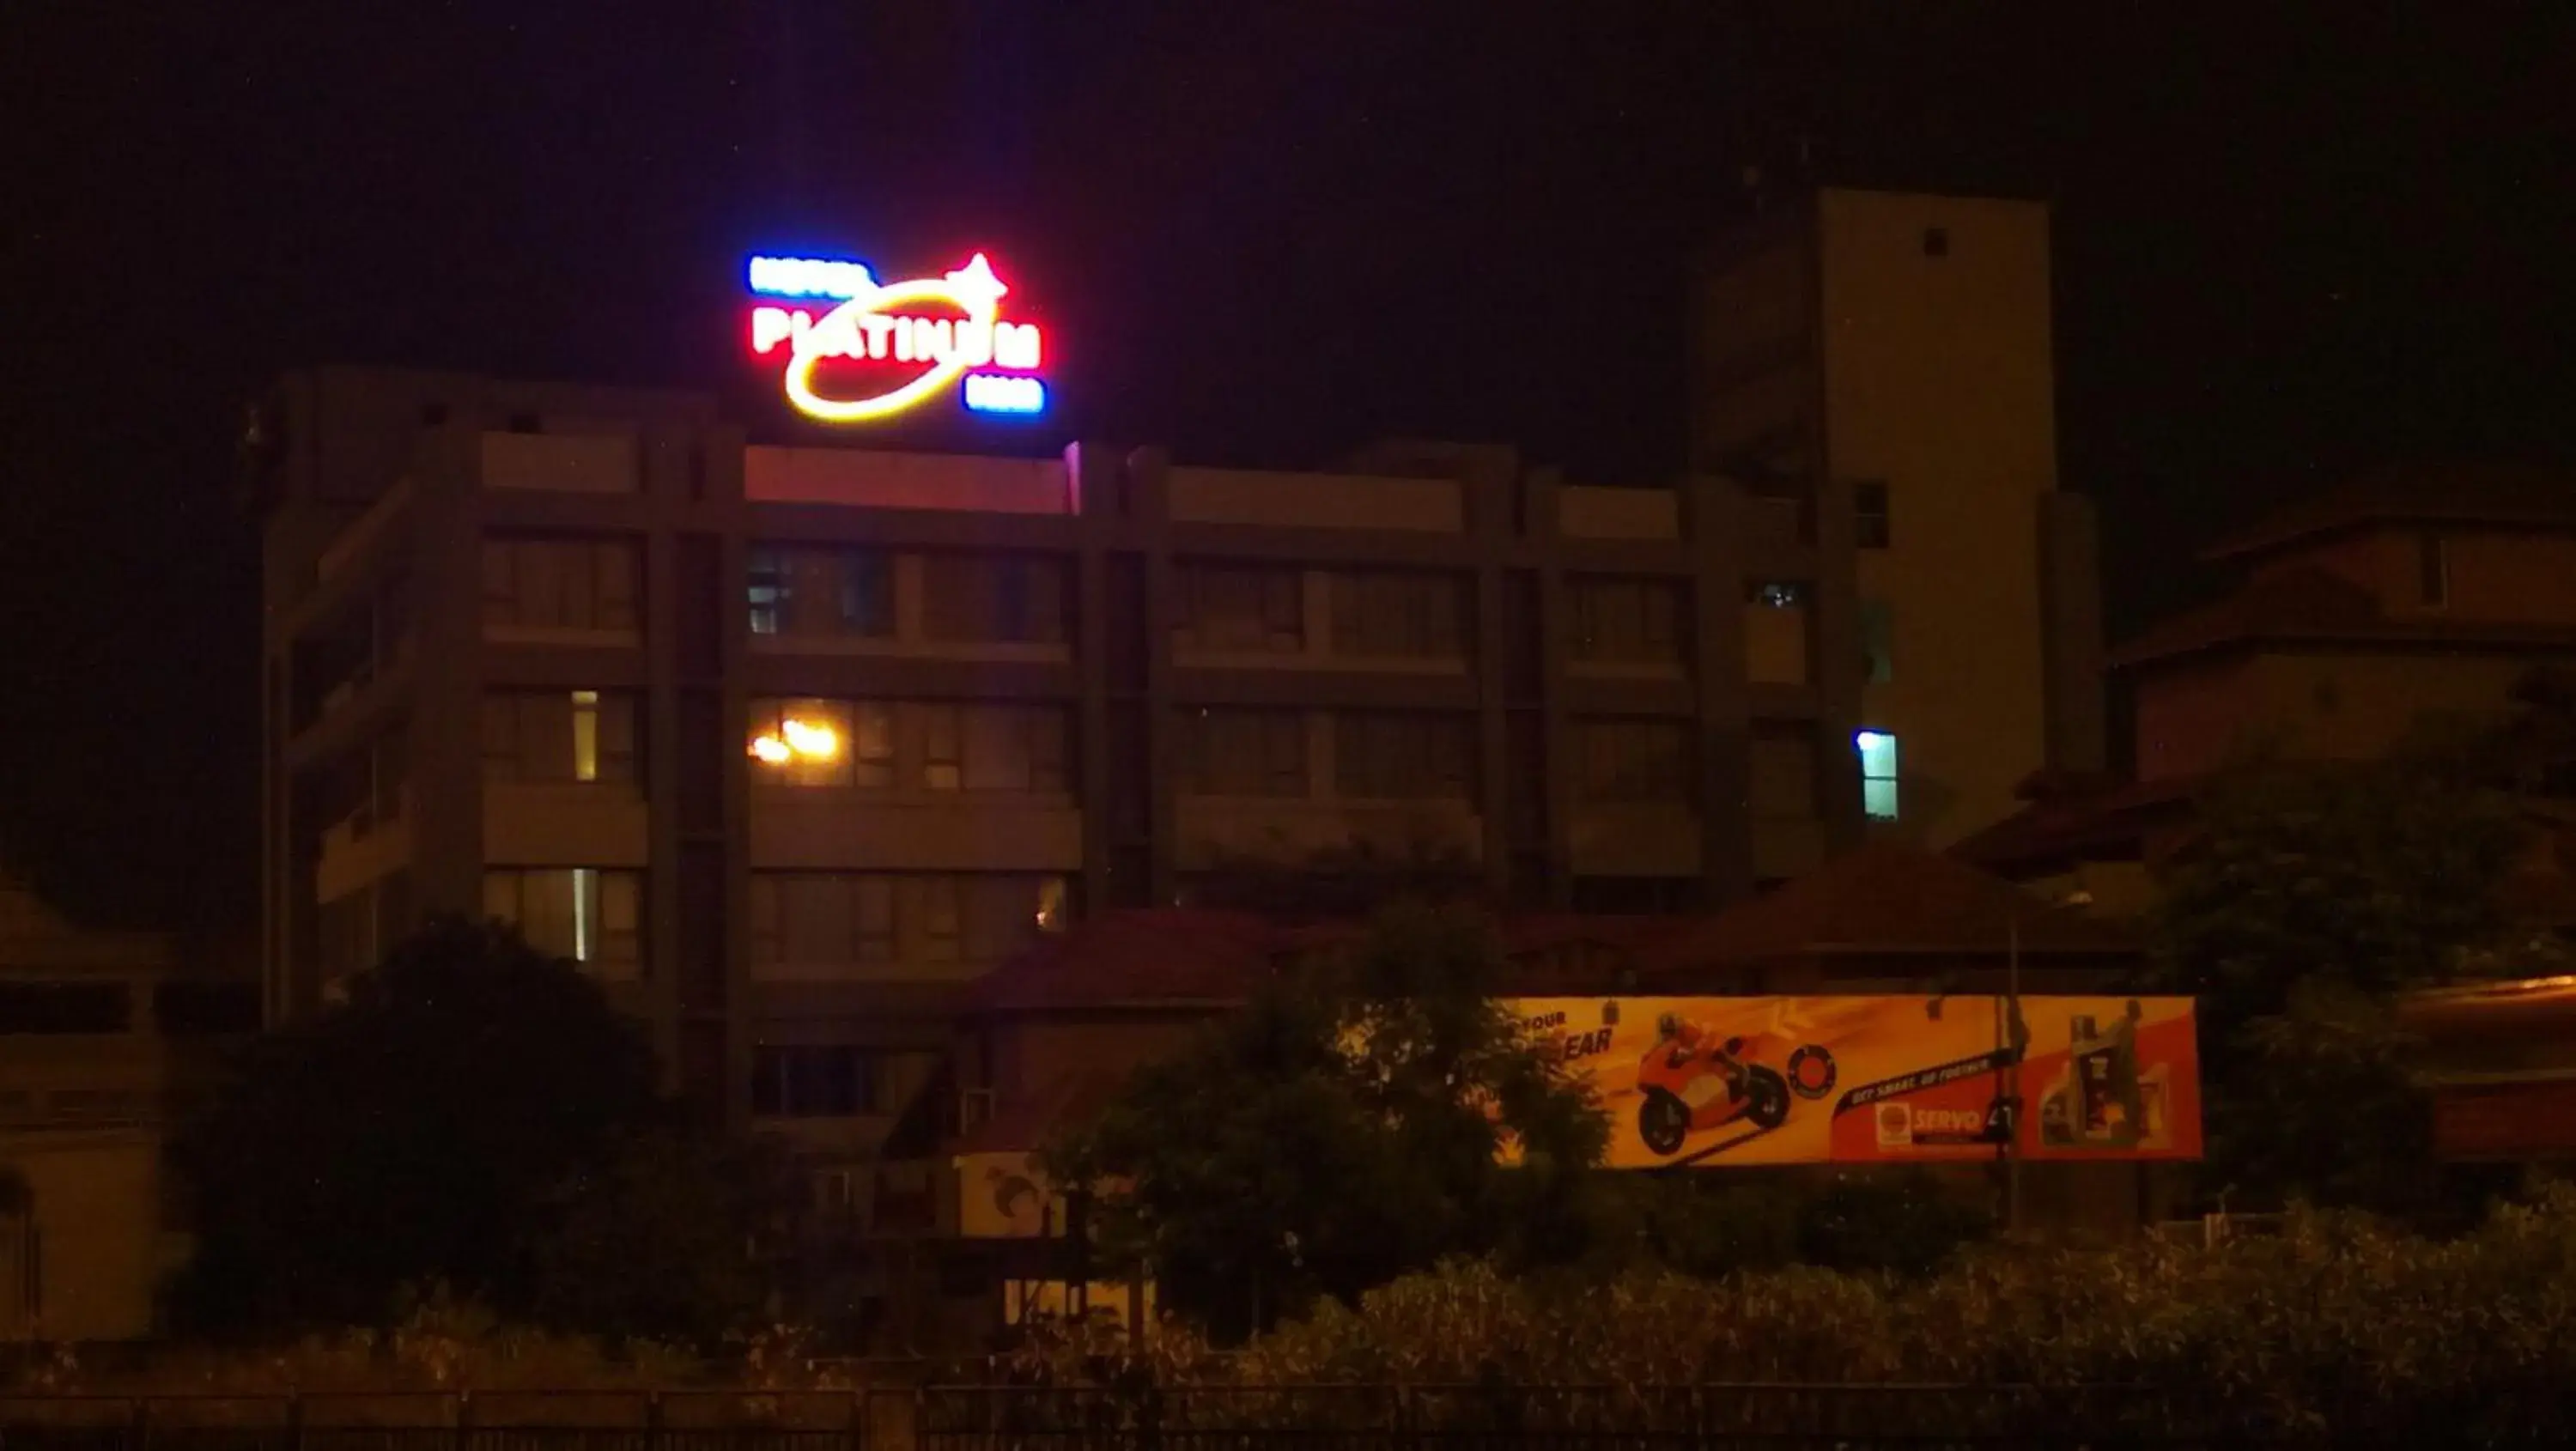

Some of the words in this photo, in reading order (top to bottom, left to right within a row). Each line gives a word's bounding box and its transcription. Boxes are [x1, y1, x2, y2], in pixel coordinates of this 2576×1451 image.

[752, 307, 1041, 369] PLATINUM
[1564, 1028, 1613, 1060] EAR
[1914, 1108, 1981, 1131] SERVO
